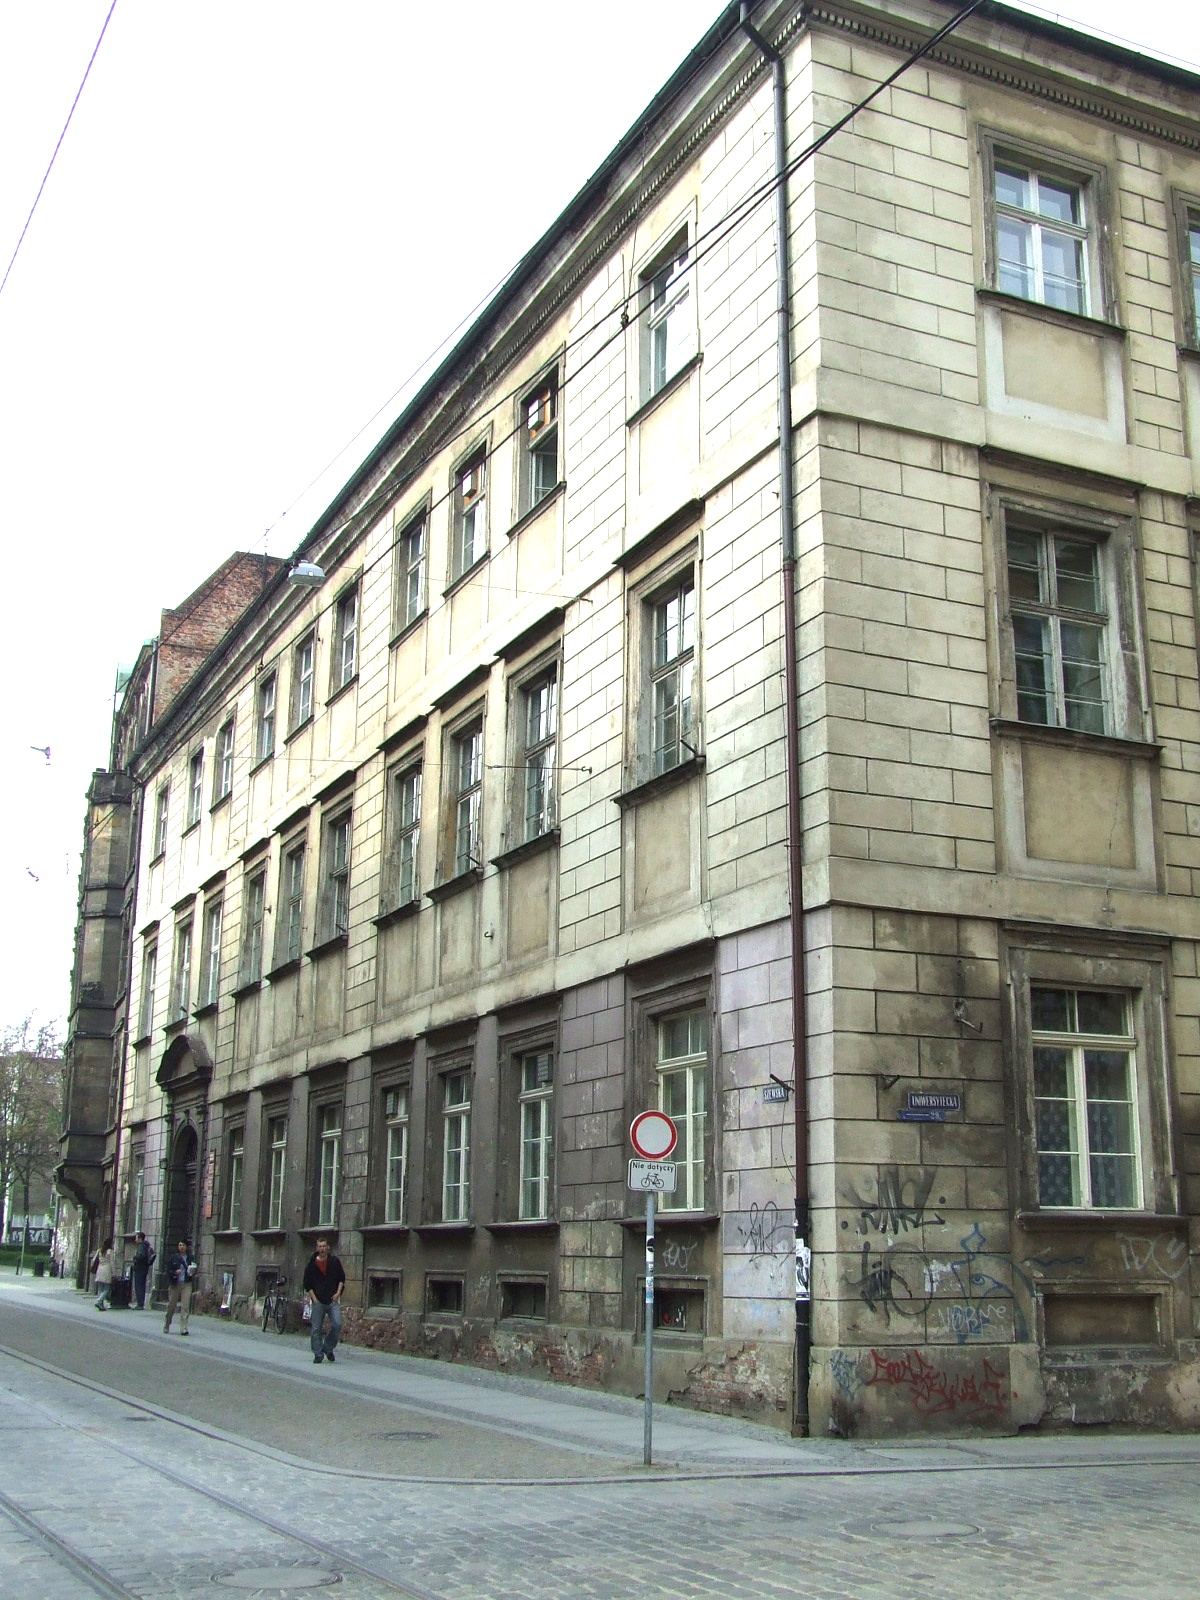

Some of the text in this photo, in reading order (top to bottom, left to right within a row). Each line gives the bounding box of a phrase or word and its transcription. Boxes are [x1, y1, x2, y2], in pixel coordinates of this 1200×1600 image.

[763, 1087, 785, 1100] SZEWSKA
[911, 1095, 958, 1107] UNIWERSYTECKA
[632, 1162, 675, 1173] Nie dotyczy
